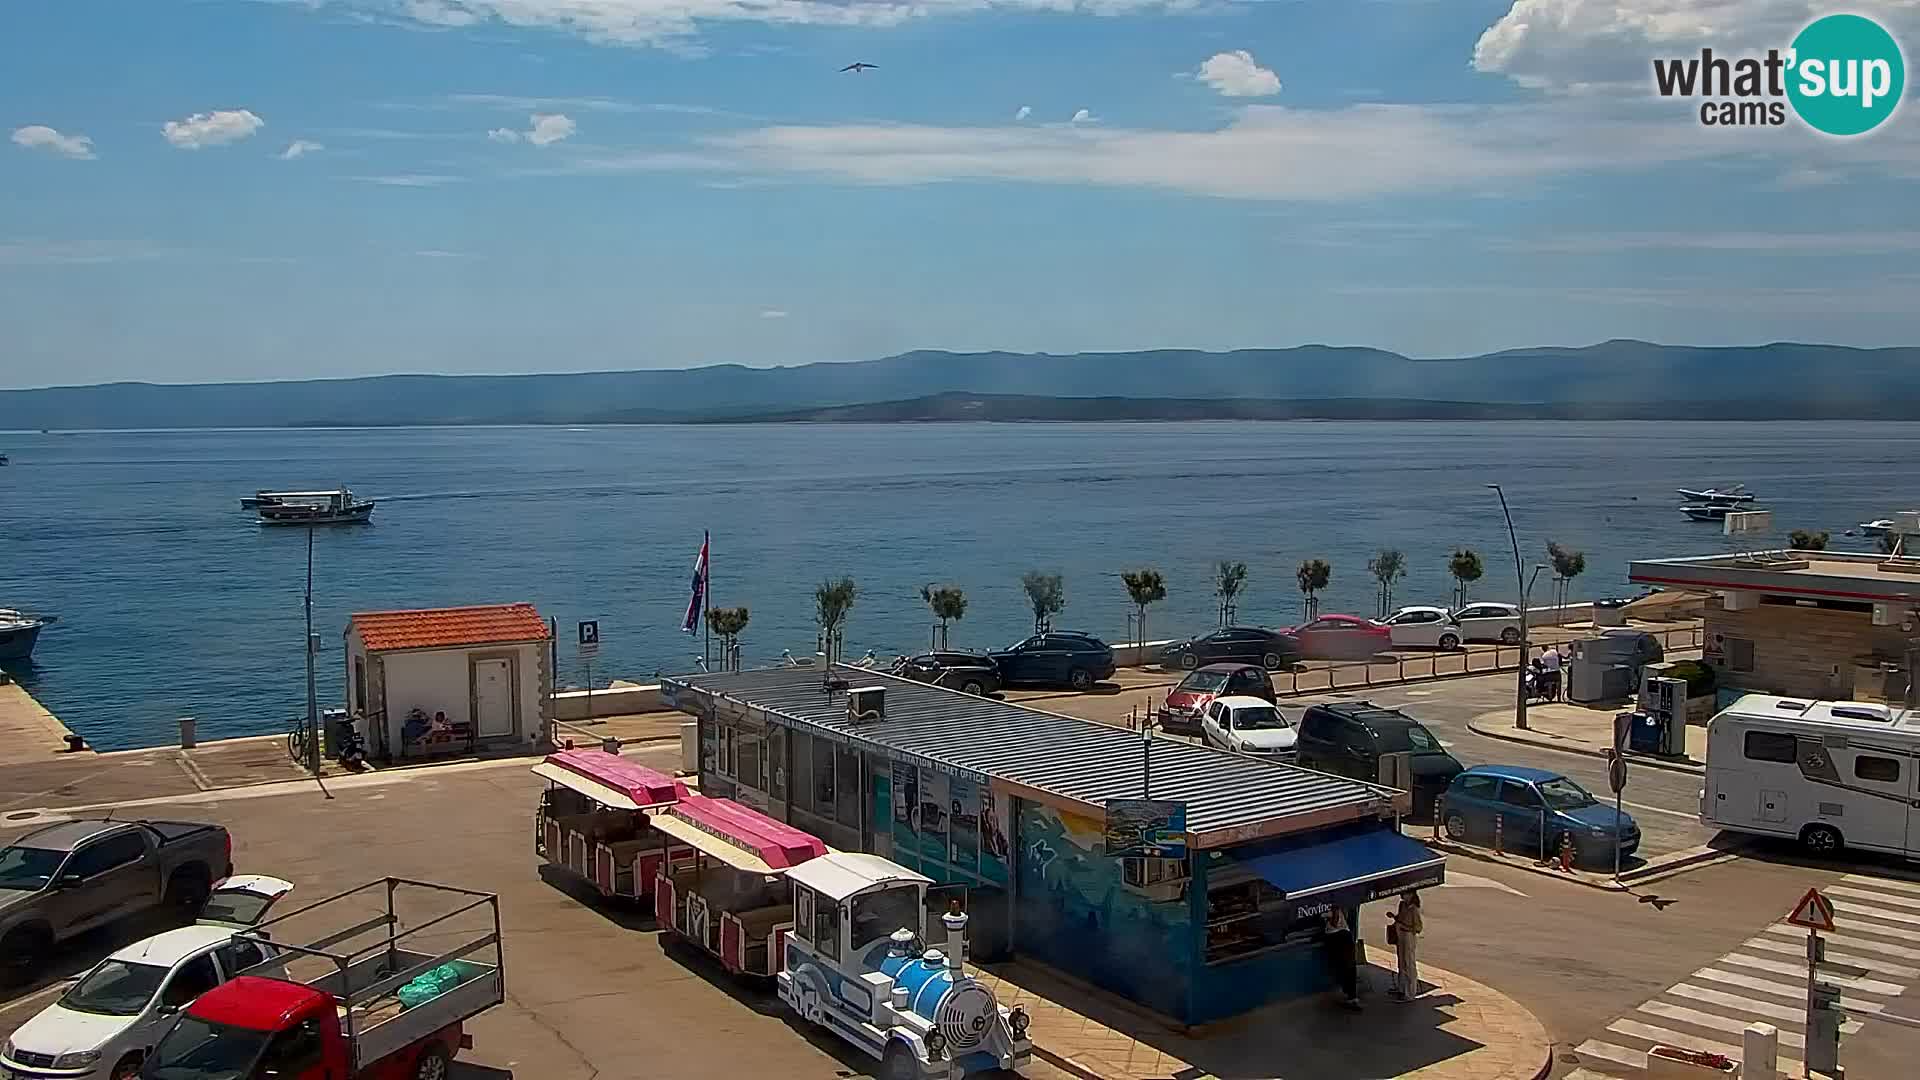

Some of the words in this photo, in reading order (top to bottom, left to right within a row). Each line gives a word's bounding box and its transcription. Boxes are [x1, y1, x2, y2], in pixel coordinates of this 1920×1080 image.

[583, 624, 594, 641] P
[935, 762, 959, 777] TICKET
[961, 770, 986, 785] OFFICE
